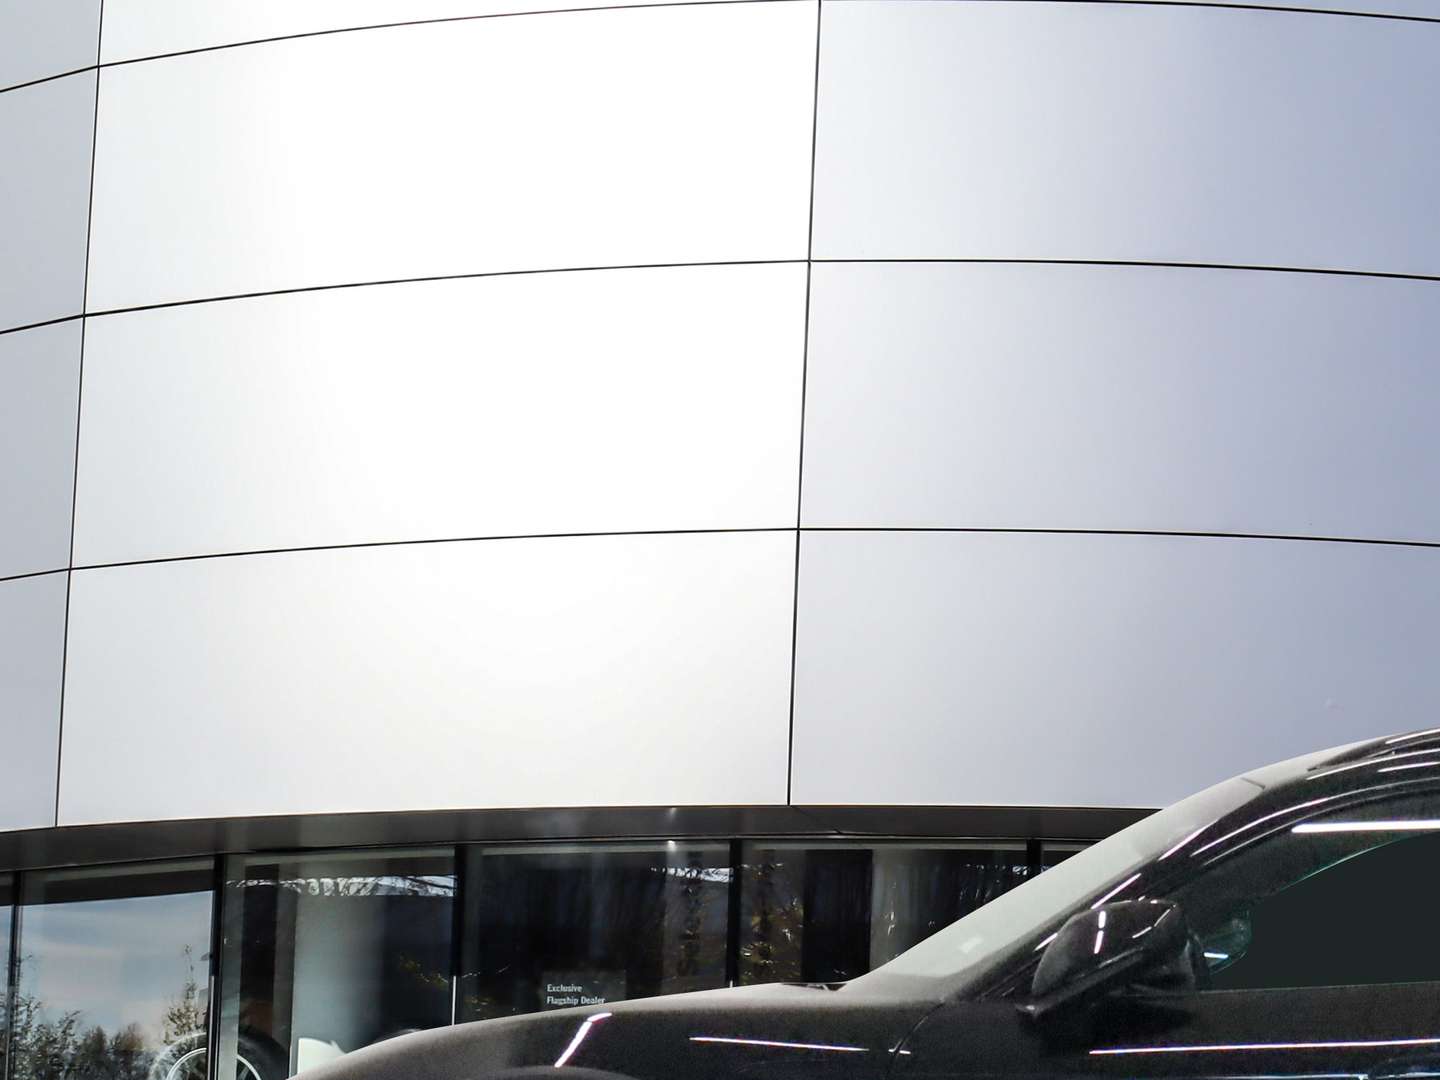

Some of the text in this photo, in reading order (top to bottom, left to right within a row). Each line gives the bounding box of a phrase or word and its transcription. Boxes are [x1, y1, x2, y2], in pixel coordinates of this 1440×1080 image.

[547, 984, 582, 992] Exclusive
[547, 996, 605, 1005] Flagship Dealer
